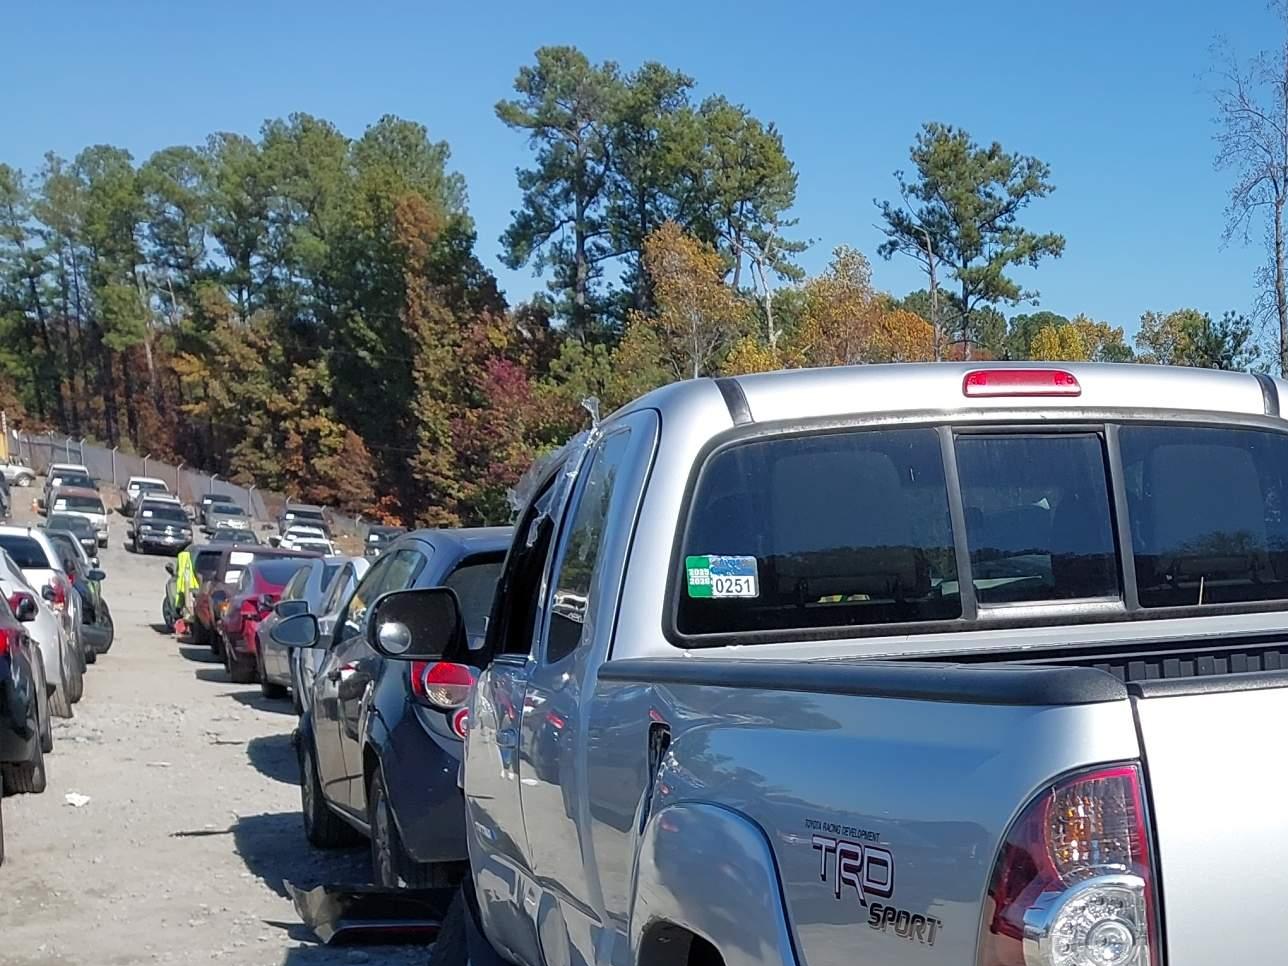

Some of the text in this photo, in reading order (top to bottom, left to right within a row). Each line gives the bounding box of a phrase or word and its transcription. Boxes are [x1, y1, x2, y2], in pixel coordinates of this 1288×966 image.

[715, 578, 751, 593] 0251
[805, 819, 881, 842] TOYOTA RACING DEVELOPMENT
[812, 834, 894, 907] TRD
[867, 902, 938, 947] SPORT
